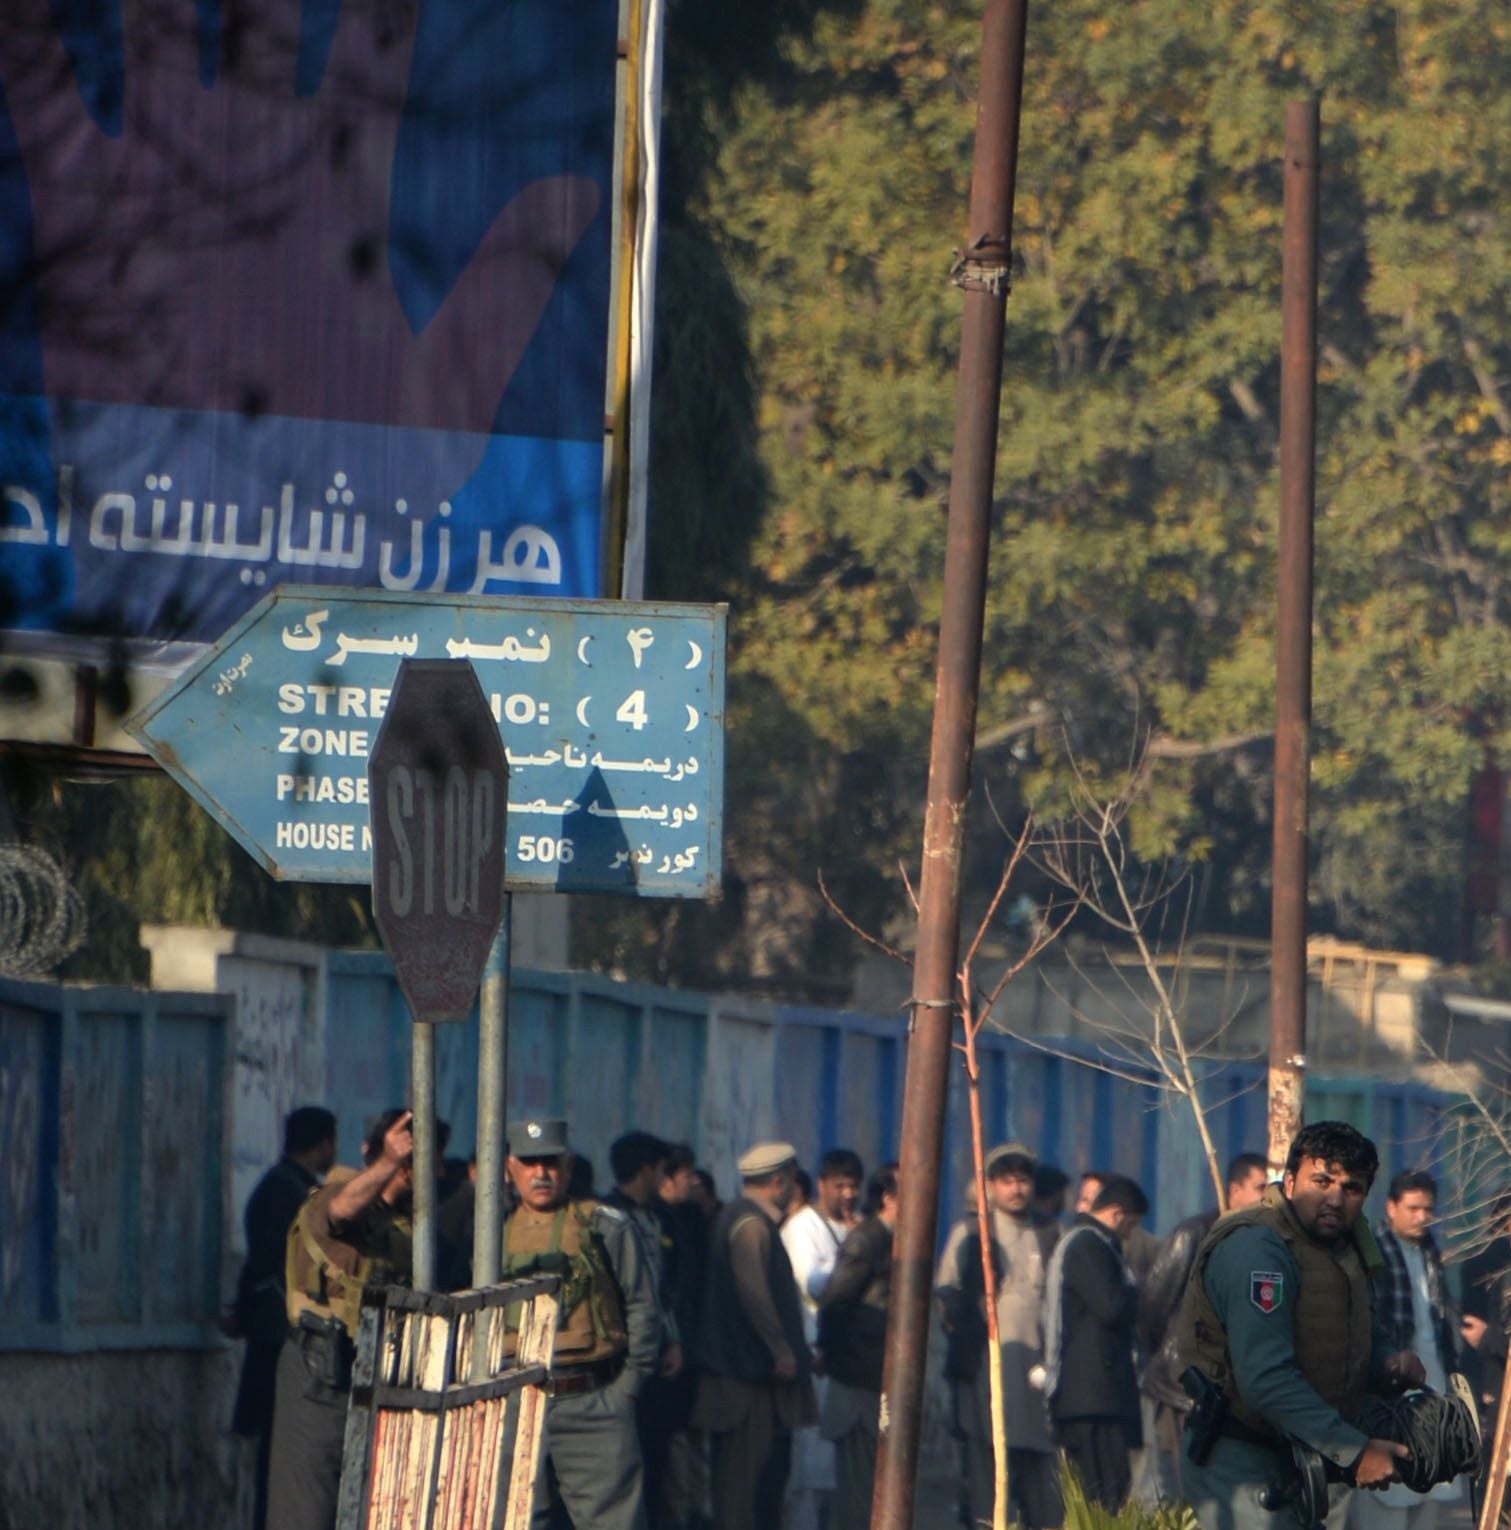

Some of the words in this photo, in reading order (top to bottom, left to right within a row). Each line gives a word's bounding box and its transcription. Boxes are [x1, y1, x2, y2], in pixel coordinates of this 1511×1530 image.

[0, 465, 73, 547] اح
[89, 471, 366, 586] شایسته
[379, 497, 450, 592] زن
[466, 525, 562, 594] هر
[277, 684, 394, 719] STRE
[277, 727, 369, 758] ZONE
[505, 744, 587, 773] ناحی
[277, 774, 369, 805] PHASE
[508, 798, 582, 816] حص
[276, 821, 355, 851] HOUSE
[516, 836, 575, 864] 506
[387, 764, 494, 917] STOP
